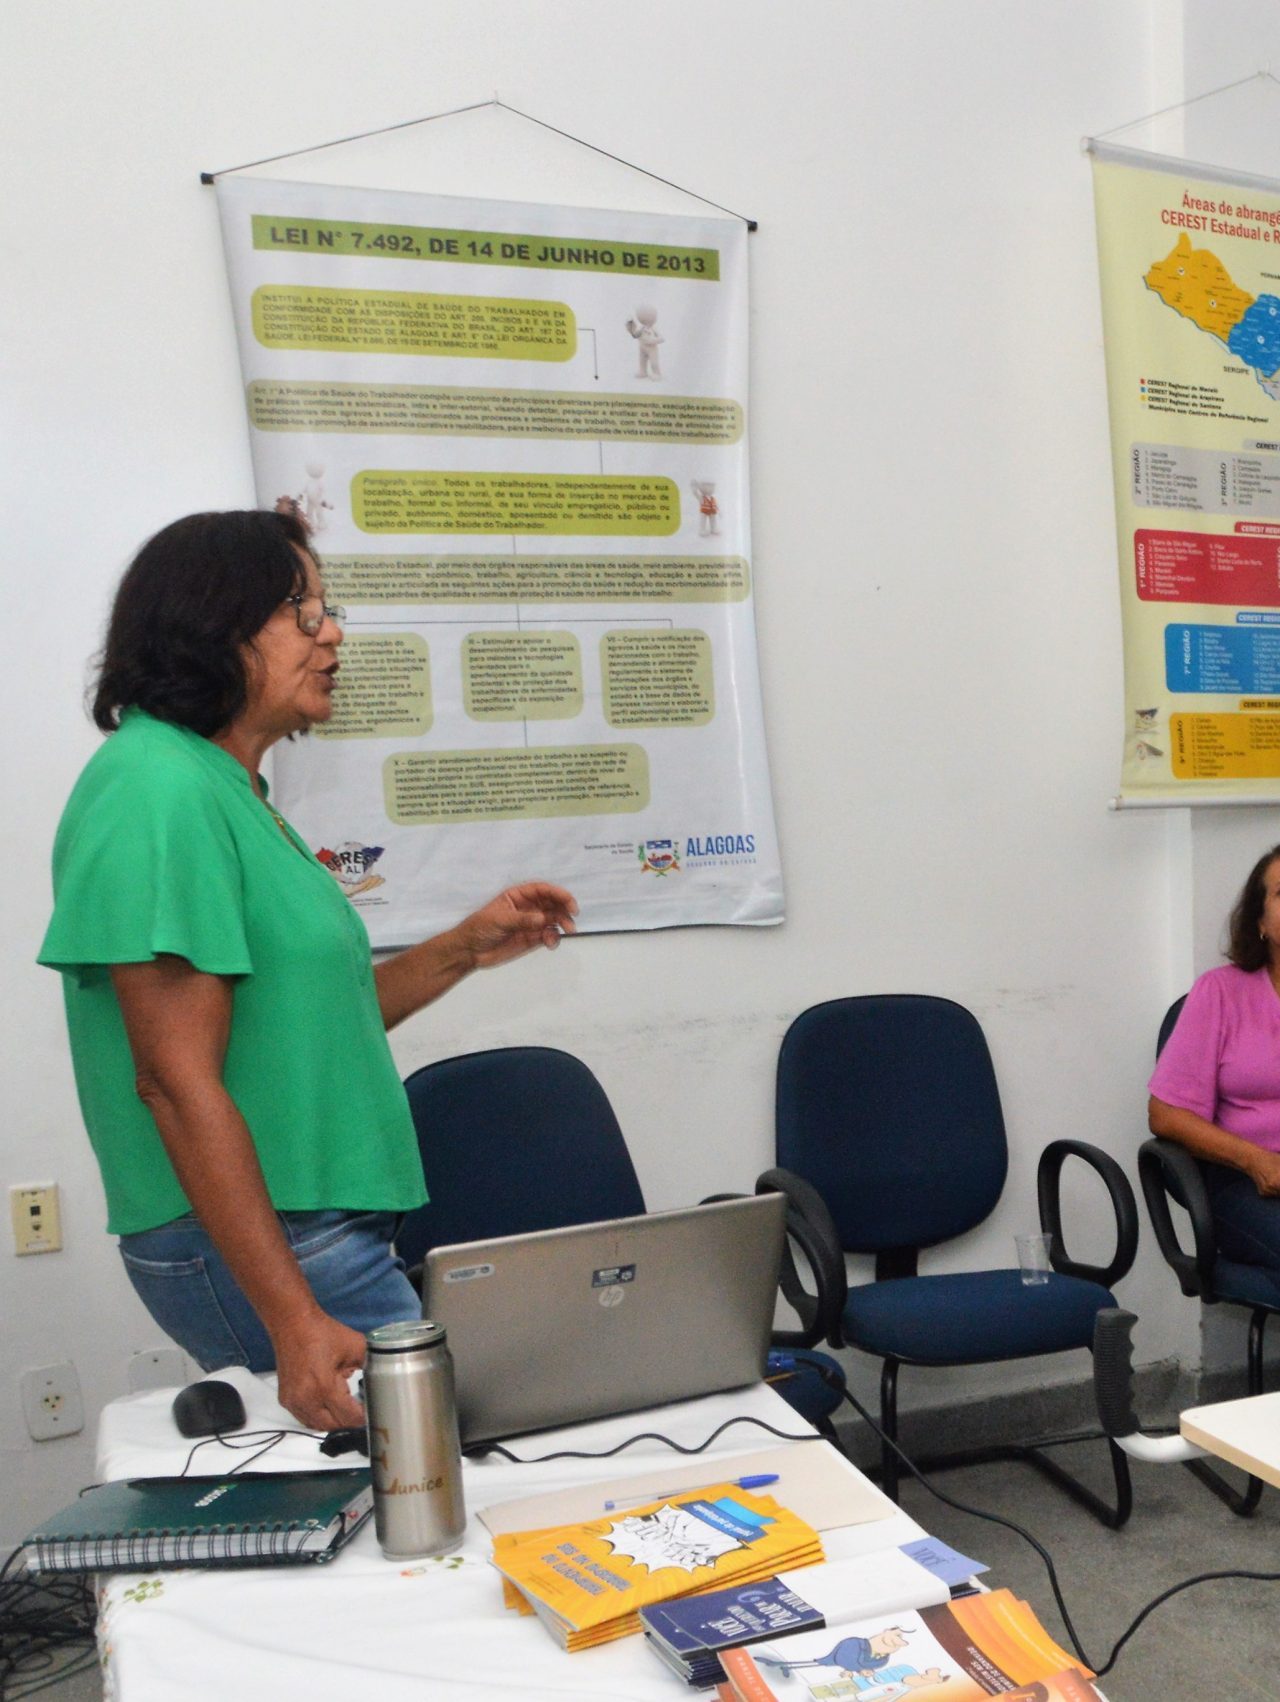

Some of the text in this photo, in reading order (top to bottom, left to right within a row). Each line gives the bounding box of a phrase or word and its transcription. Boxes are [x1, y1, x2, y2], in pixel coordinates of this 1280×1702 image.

[1182, 190, 1217, 212] Áreas
[1219, 199, 1233, 214] de
[1161, 209, 1208, 232] CEREST
[1211, 219, 1261, 242] Estadual
[1264, 228, 1271, 241] e
[270, 226, 308, 246] LEI
[351, 232, 422, 256] 7.492,
[429, 238, 459, 256] DE
[468, 240, 494, 258] 14
[501, 242, 530, 260] DE
[538, 246, 614, 266] JUNHO
[622, 252, 649, 268] DE
[656, 255, 705, 273] 2013
[433, 302, 463, 312] SAÚDE
[468, 305, 480, 313] DO
[485, 306, 550, 318] TRABALHADOR
[1256, 442, 1278, 450] CEREST
[444, 478, 470, 487] Todos
[1138, 544, 1146, 578] REGIÃO
[686, 835, 755, 857] ALAGOAS
[346, 865, 361, 874] AL
